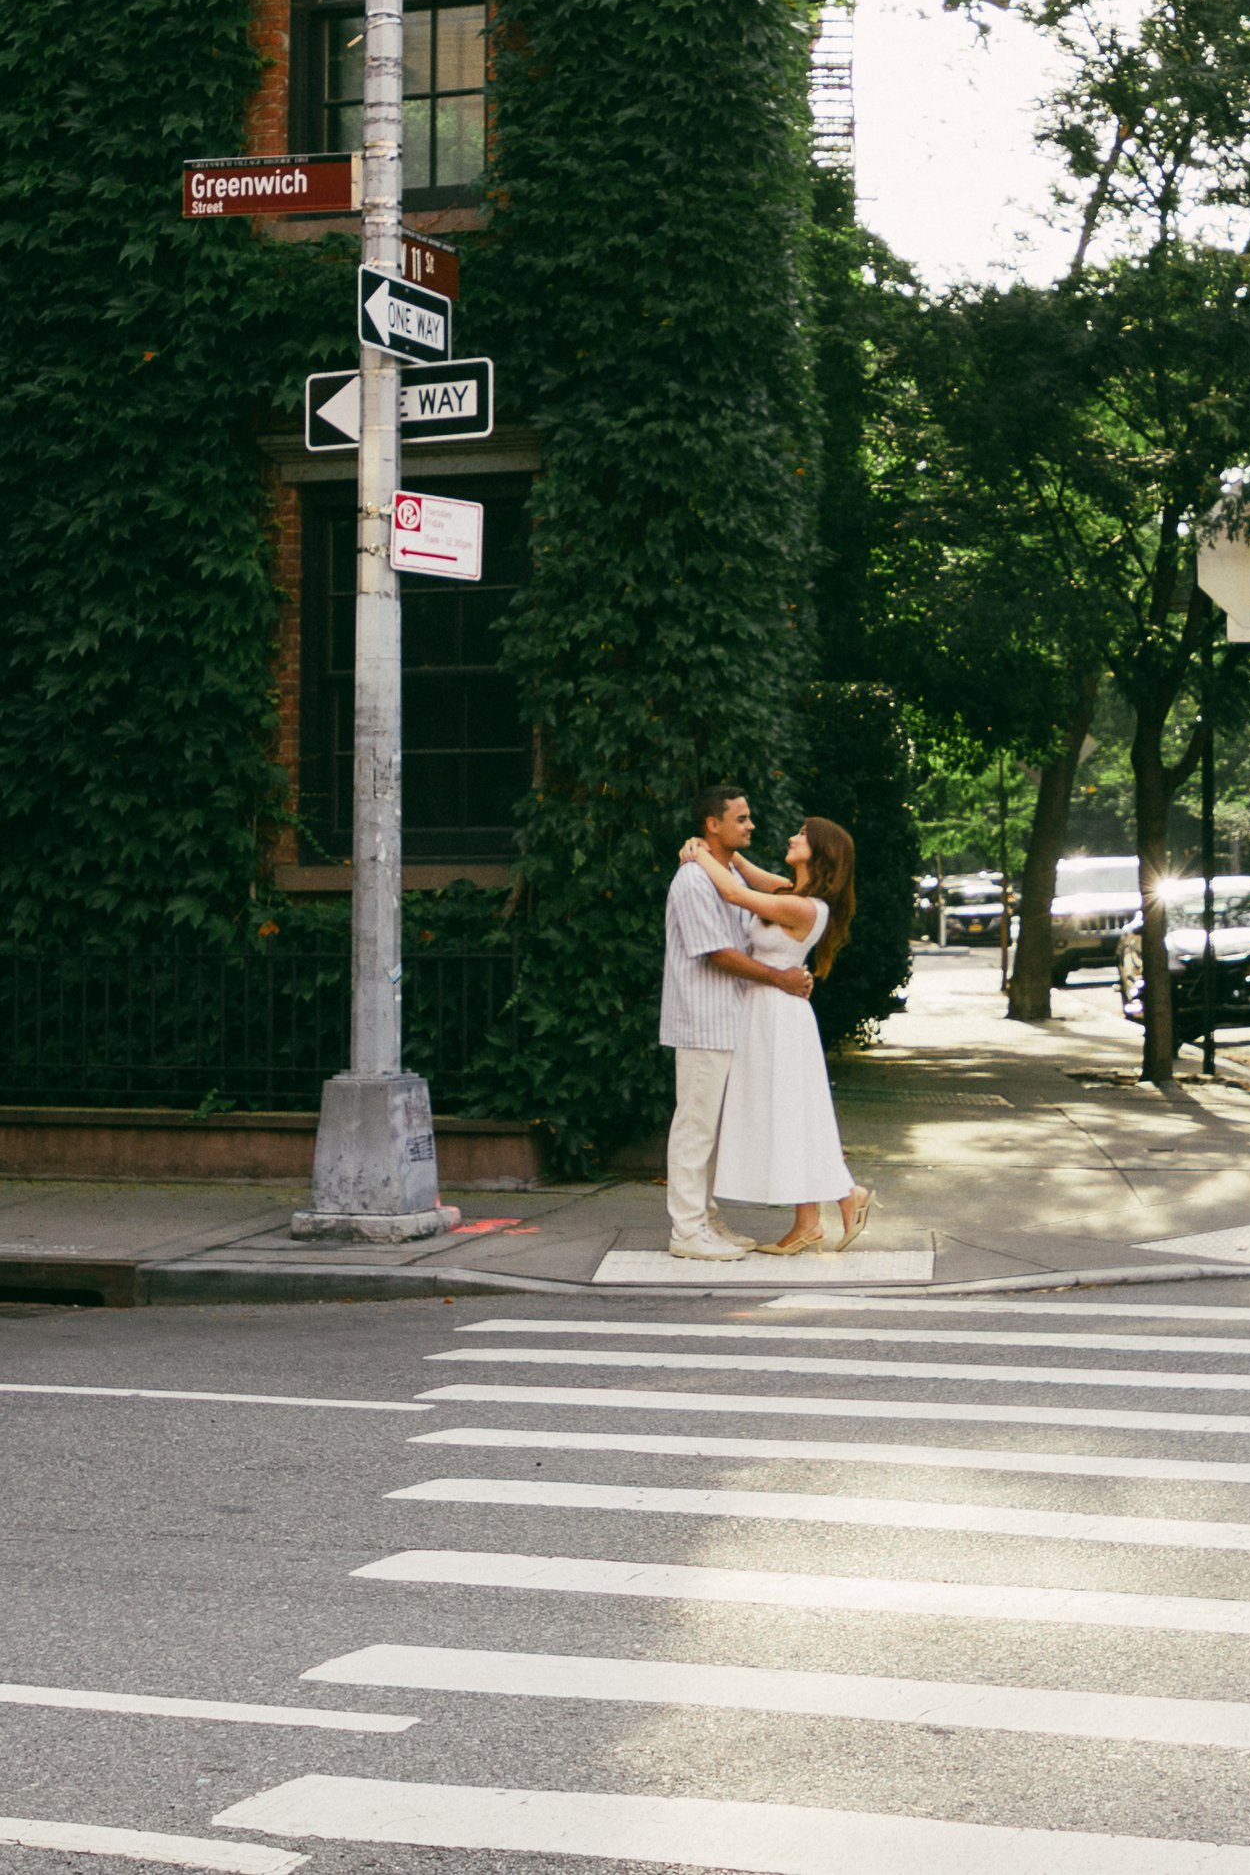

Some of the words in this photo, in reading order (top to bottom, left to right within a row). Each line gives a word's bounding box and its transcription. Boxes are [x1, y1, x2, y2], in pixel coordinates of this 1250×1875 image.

[191, 168, 308, 199] Greenwich
[191, 200, 224, 215] Street
[411, 246, 421, 282] 11
[425, 251, 435, 274] St
[388, 301, 412, 334] ONE
[416, 309, 440, 343] WAY
[418, 385, 469, 415] WAY
